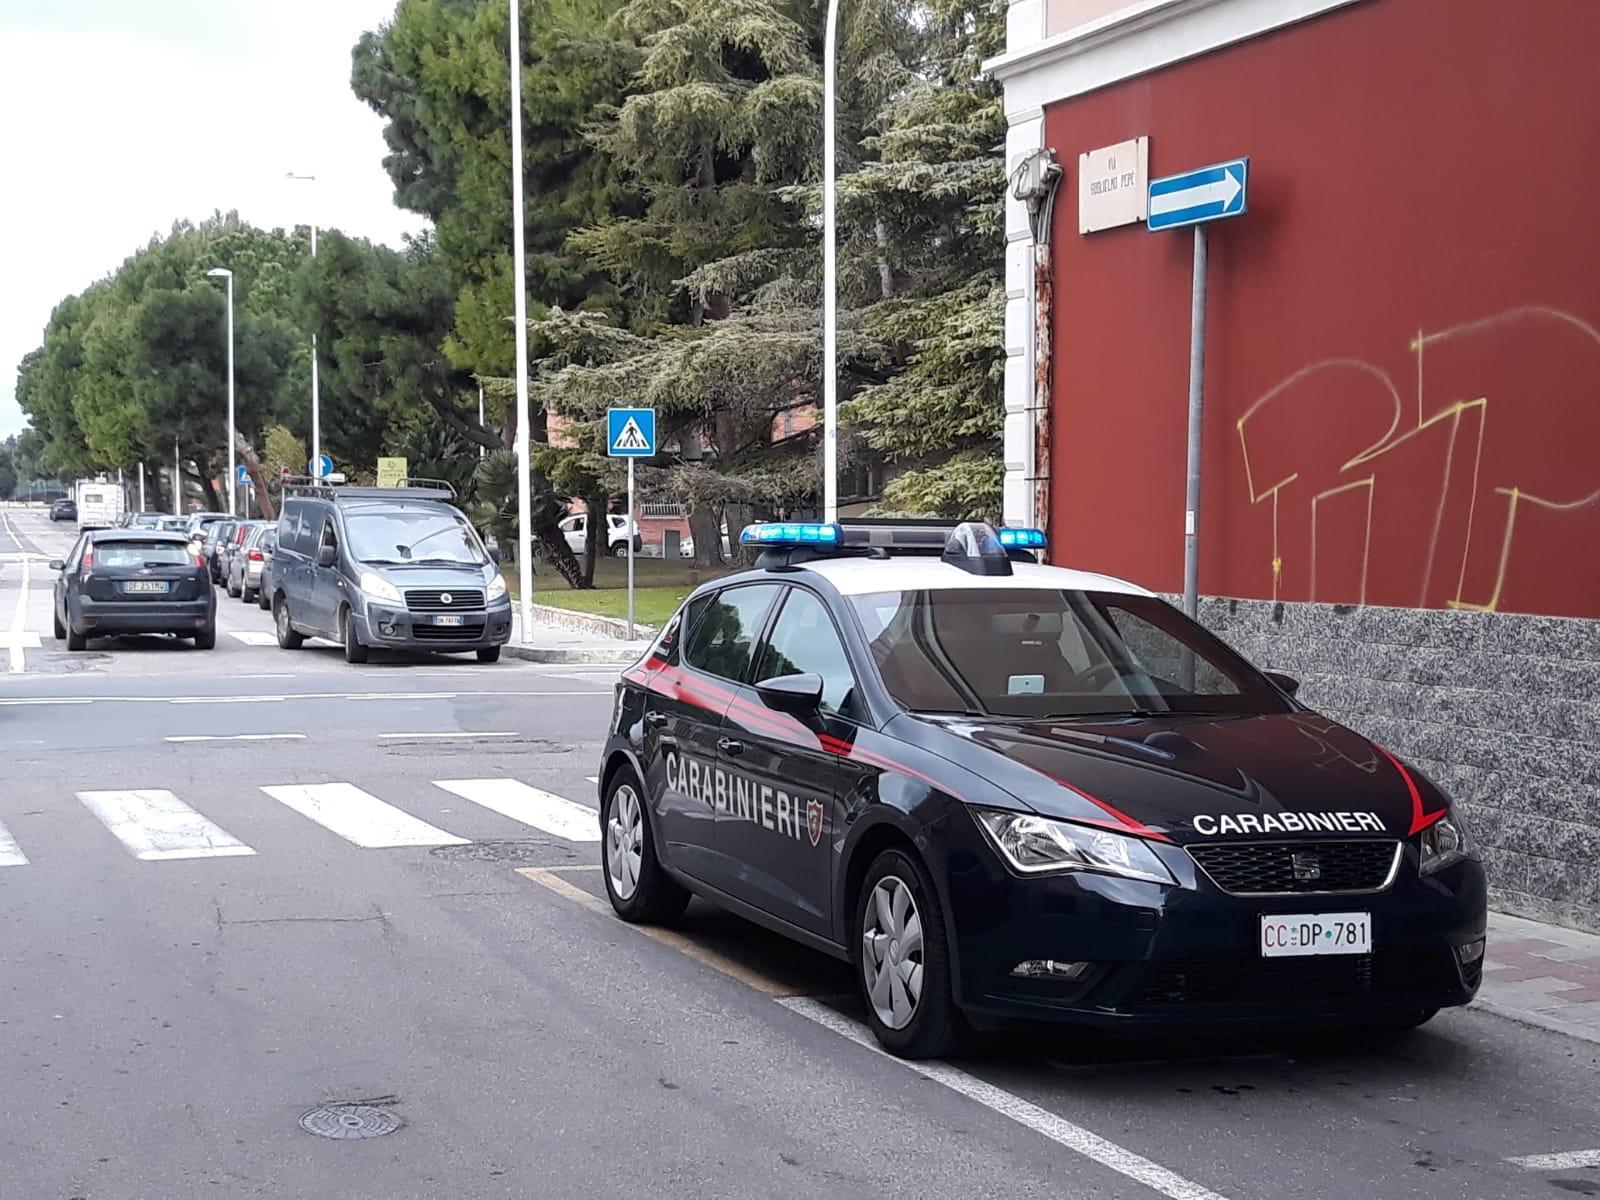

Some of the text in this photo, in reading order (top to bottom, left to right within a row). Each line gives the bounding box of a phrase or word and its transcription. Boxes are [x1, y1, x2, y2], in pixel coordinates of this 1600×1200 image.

[1108, 156, 1116, 171] VIA
[666, 751, 801, 841] CARABINIERI
[1193, 811, 1386, 836] CARABINIERI
[1264, 922, 1366, 948] CC DP 781
